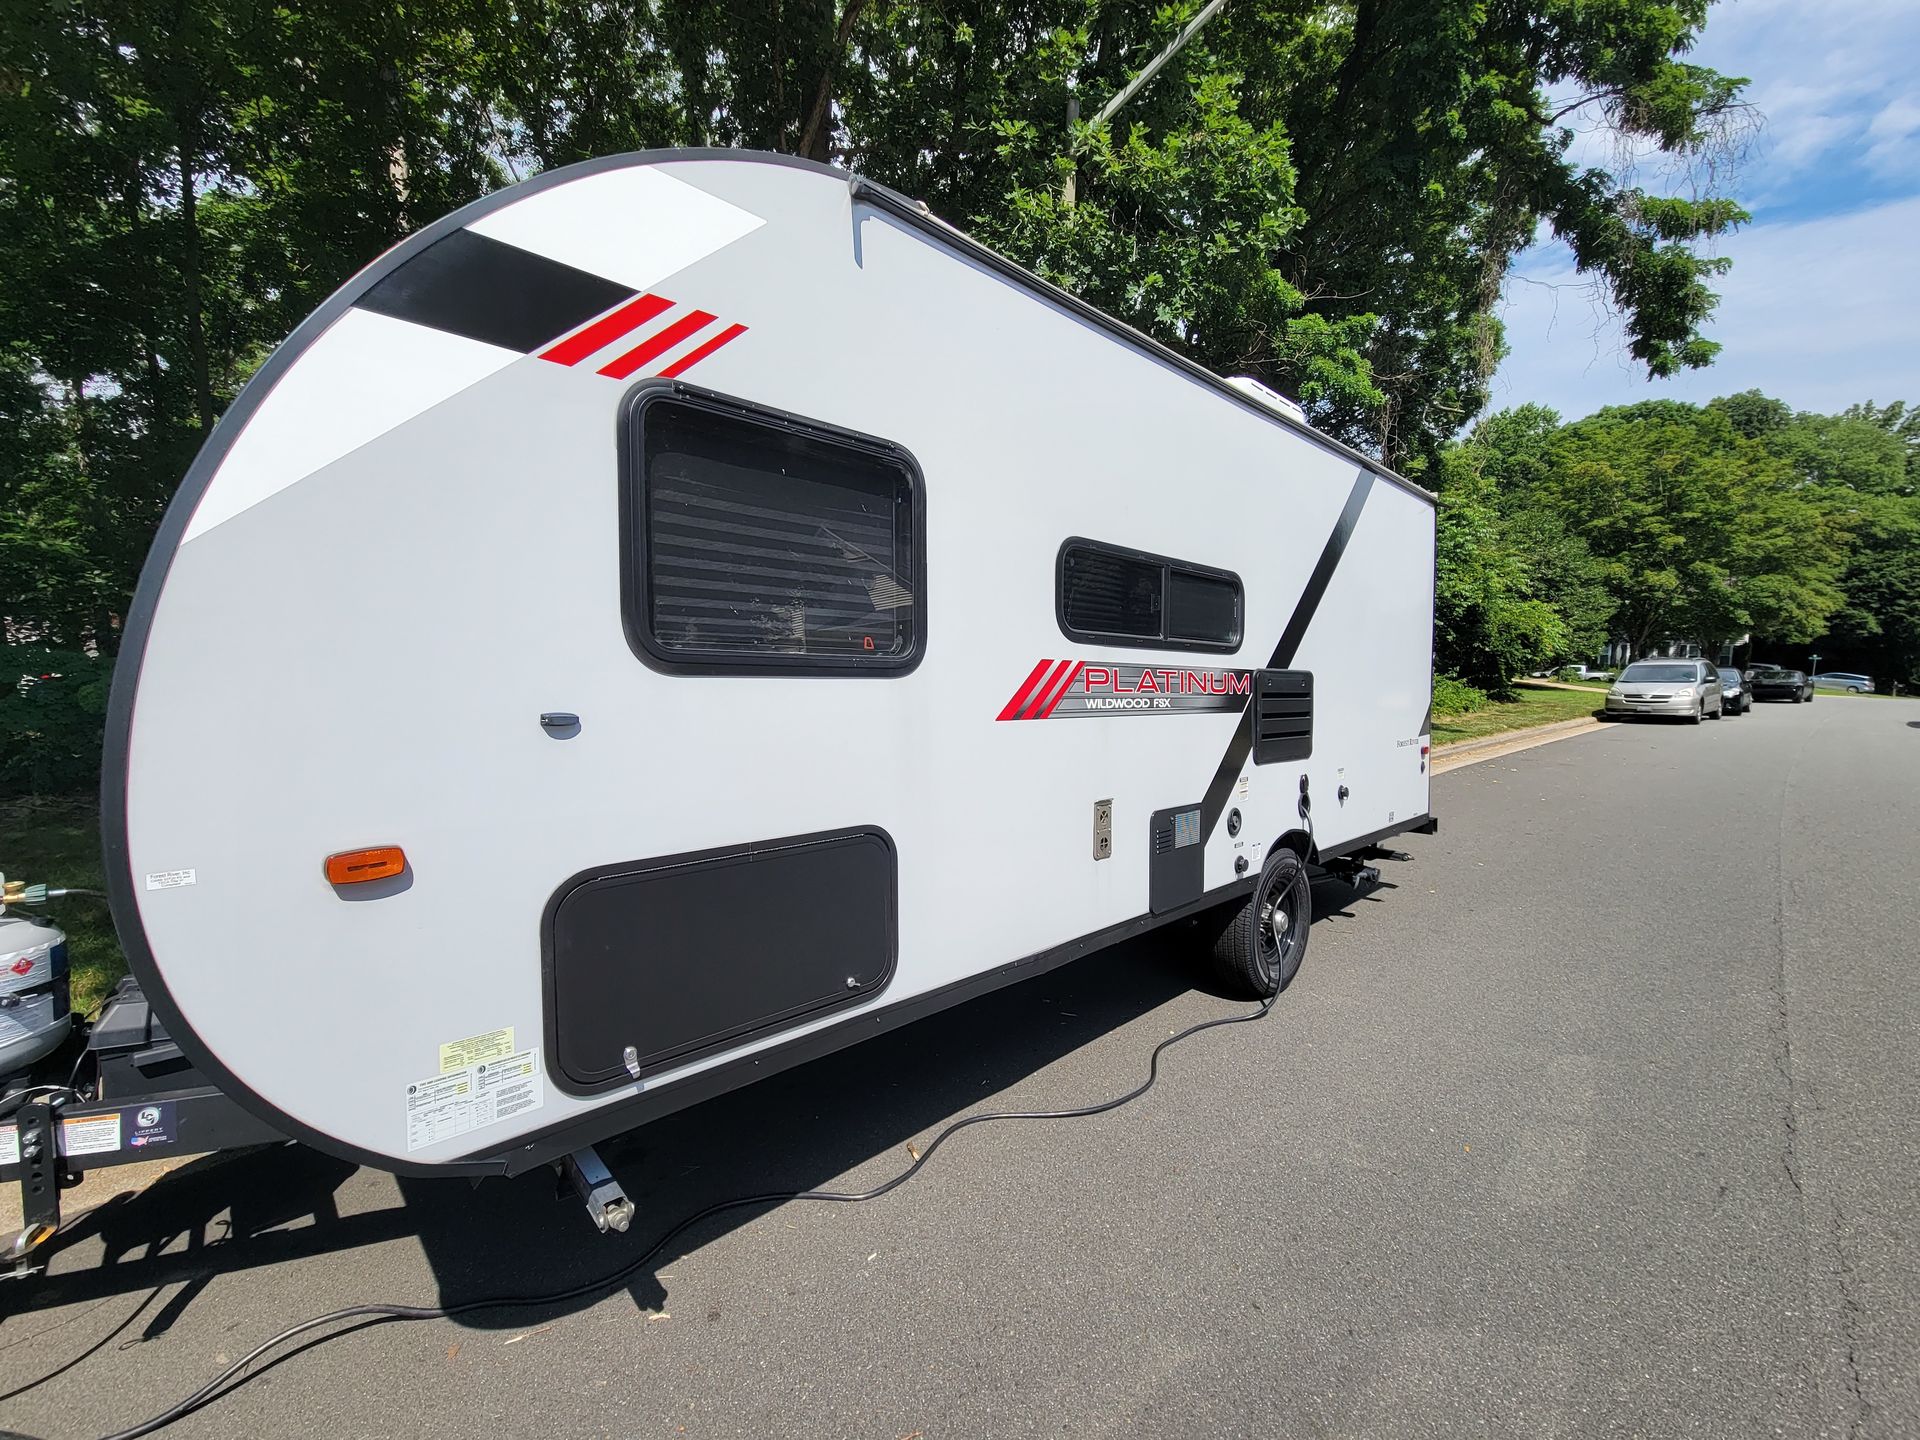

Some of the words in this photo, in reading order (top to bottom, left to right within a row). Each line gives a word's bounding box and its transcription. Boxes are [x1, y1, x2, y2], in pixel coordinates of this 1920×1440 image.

[1084, 666, 1250, 695] PLATINUM
[1085, 698, 1150, 708] WILDWOOD
[1153, 697, 1171, 708] FSX
